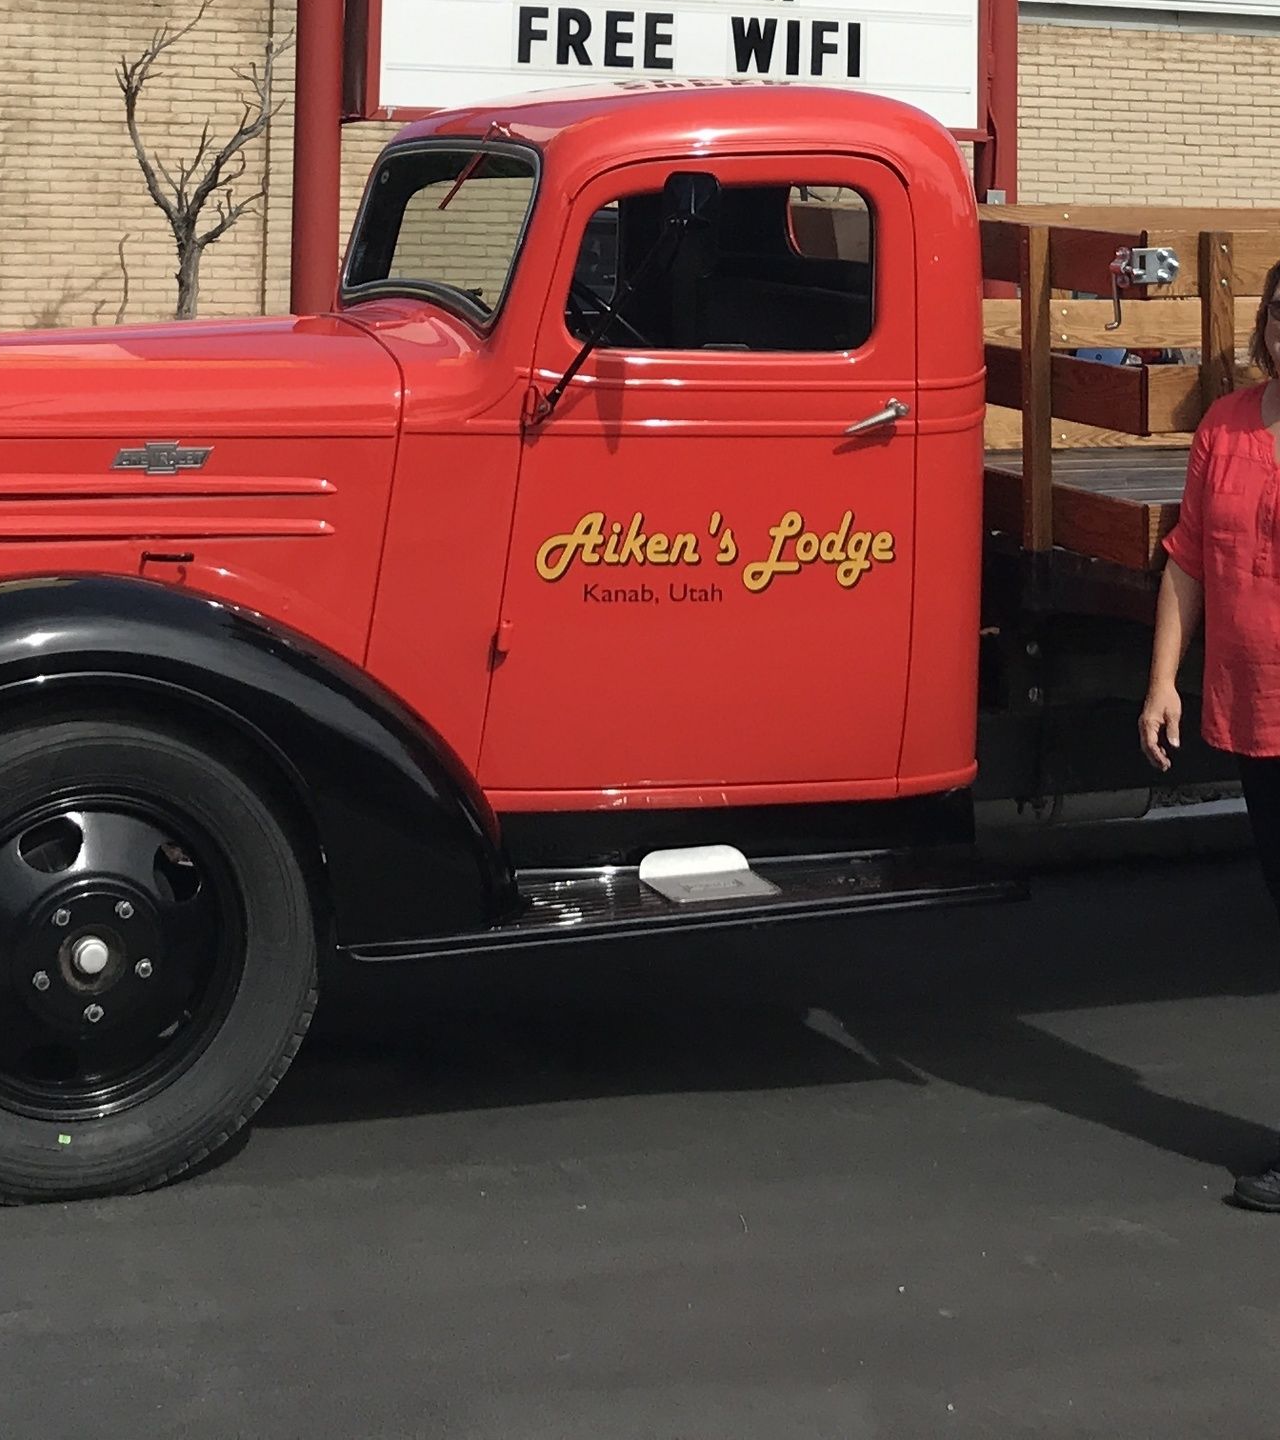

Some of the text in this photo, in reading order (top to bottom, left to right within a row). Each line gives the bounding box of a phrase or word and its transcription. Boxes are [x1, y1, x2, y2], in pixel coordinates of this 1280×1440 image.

[517, 6, 861, 78] FREE WIFI
[535, 510, 895, 593] Aiken's Lodge
[583, 583, 723, 605] Kanab, Utah
